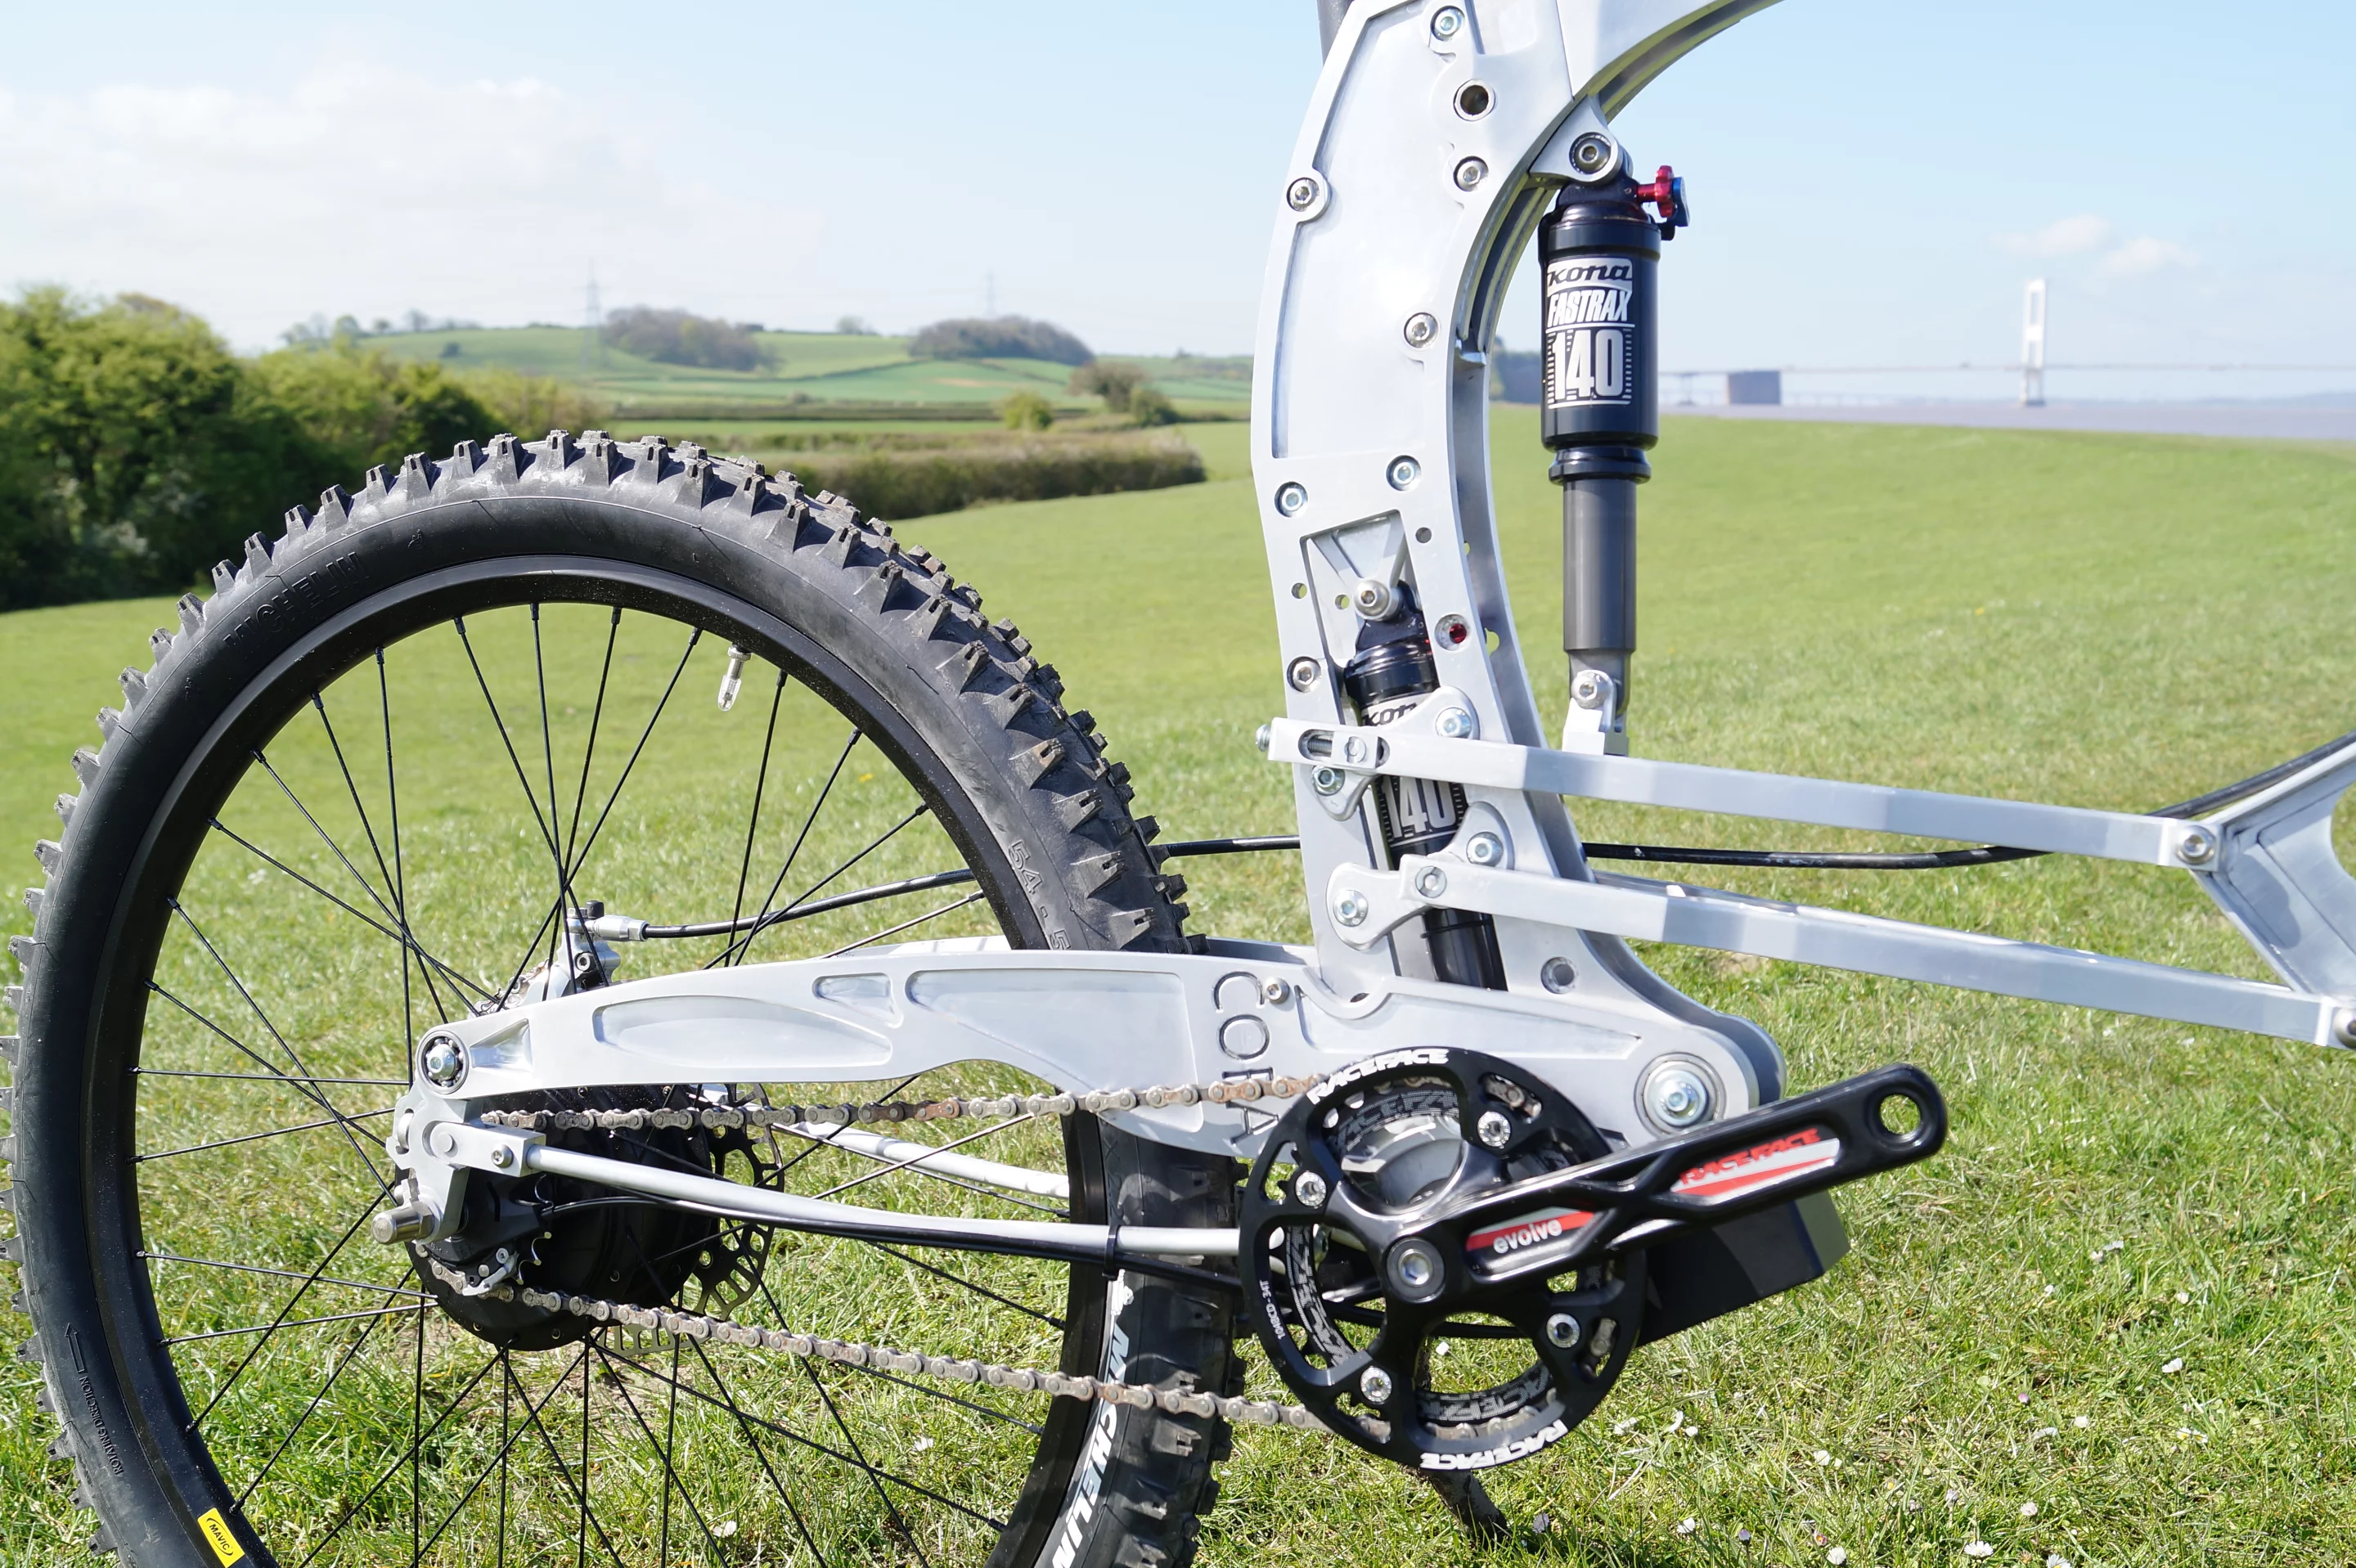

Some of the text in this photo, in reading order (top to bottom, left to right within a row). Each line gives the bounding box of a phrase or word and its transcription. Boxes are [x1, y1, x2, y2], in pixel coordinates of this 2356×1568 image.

[1547, 289, 1633, 327] FASTRAX
[1552, 329, 1624, 400] 140
[222, 551, 370, 657] MICHELIN
[1380, 775, 1456, 838] 140
[1306, 1048, 1450, 1105] RACEFACE
[1679, 1128, 1821, 1184] RACEFACE
[1493, 1219, 1562, 1254] evolve
[79, 1376, 104, 1428] DIRECTION
[1052, 1320, 1130, 1568] MCHELIN
[1419, 1418, 1569, 1470] RACEFACE
[209, 1523, 231, 1551] MAVIC
